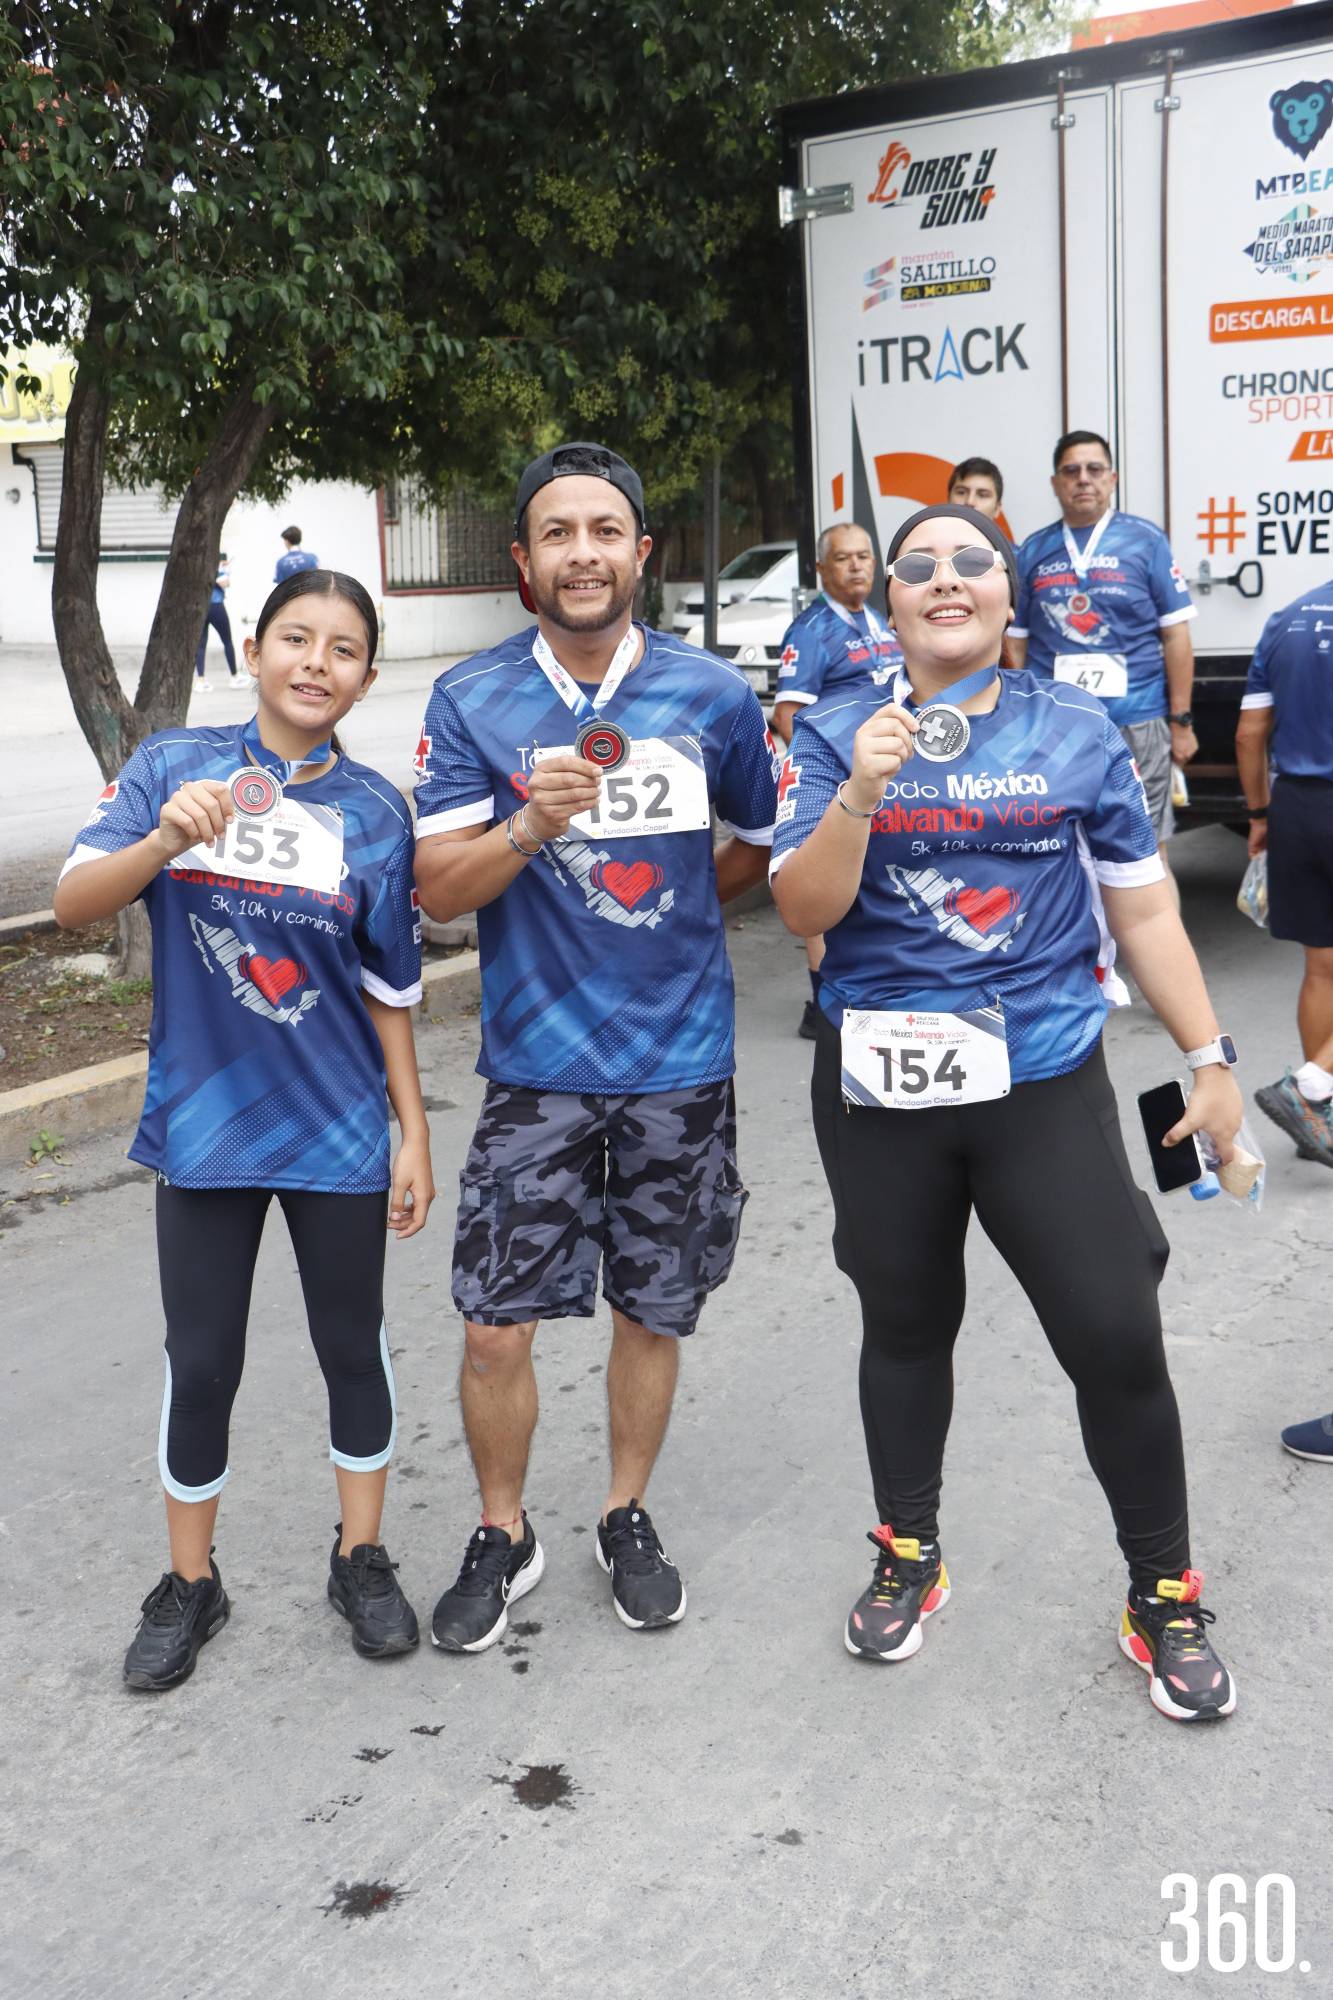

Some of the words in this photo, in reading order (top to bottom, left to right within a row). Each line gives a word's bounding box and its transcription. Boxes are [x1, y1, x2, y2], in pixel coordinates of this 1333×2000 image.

[1258, 222, 1290, 240] MEDIO
[1254, 240, 1279, 263] DEL
[901, 256, 997, 284] SALTILLO
[923, 278, 990, 299] MODERNA
[1214, 305, 1316, 333] DESCARGA
[857, 322, 1030, 387] iTRACK
[1257, 519, 1331, 556] EVE
[1075, 670, 1104, 690] 47
[946, 769, 1048, 801] México
[991, 837, 1061, 855] caminata
[211, 894, 234, 917] 5k,
[238, 899, 267, 919] 10k
[272, 909, 282, 923] y
[876, 1046, 967, 1095] 154
[933, 1094, 963, 1105] Coppel
